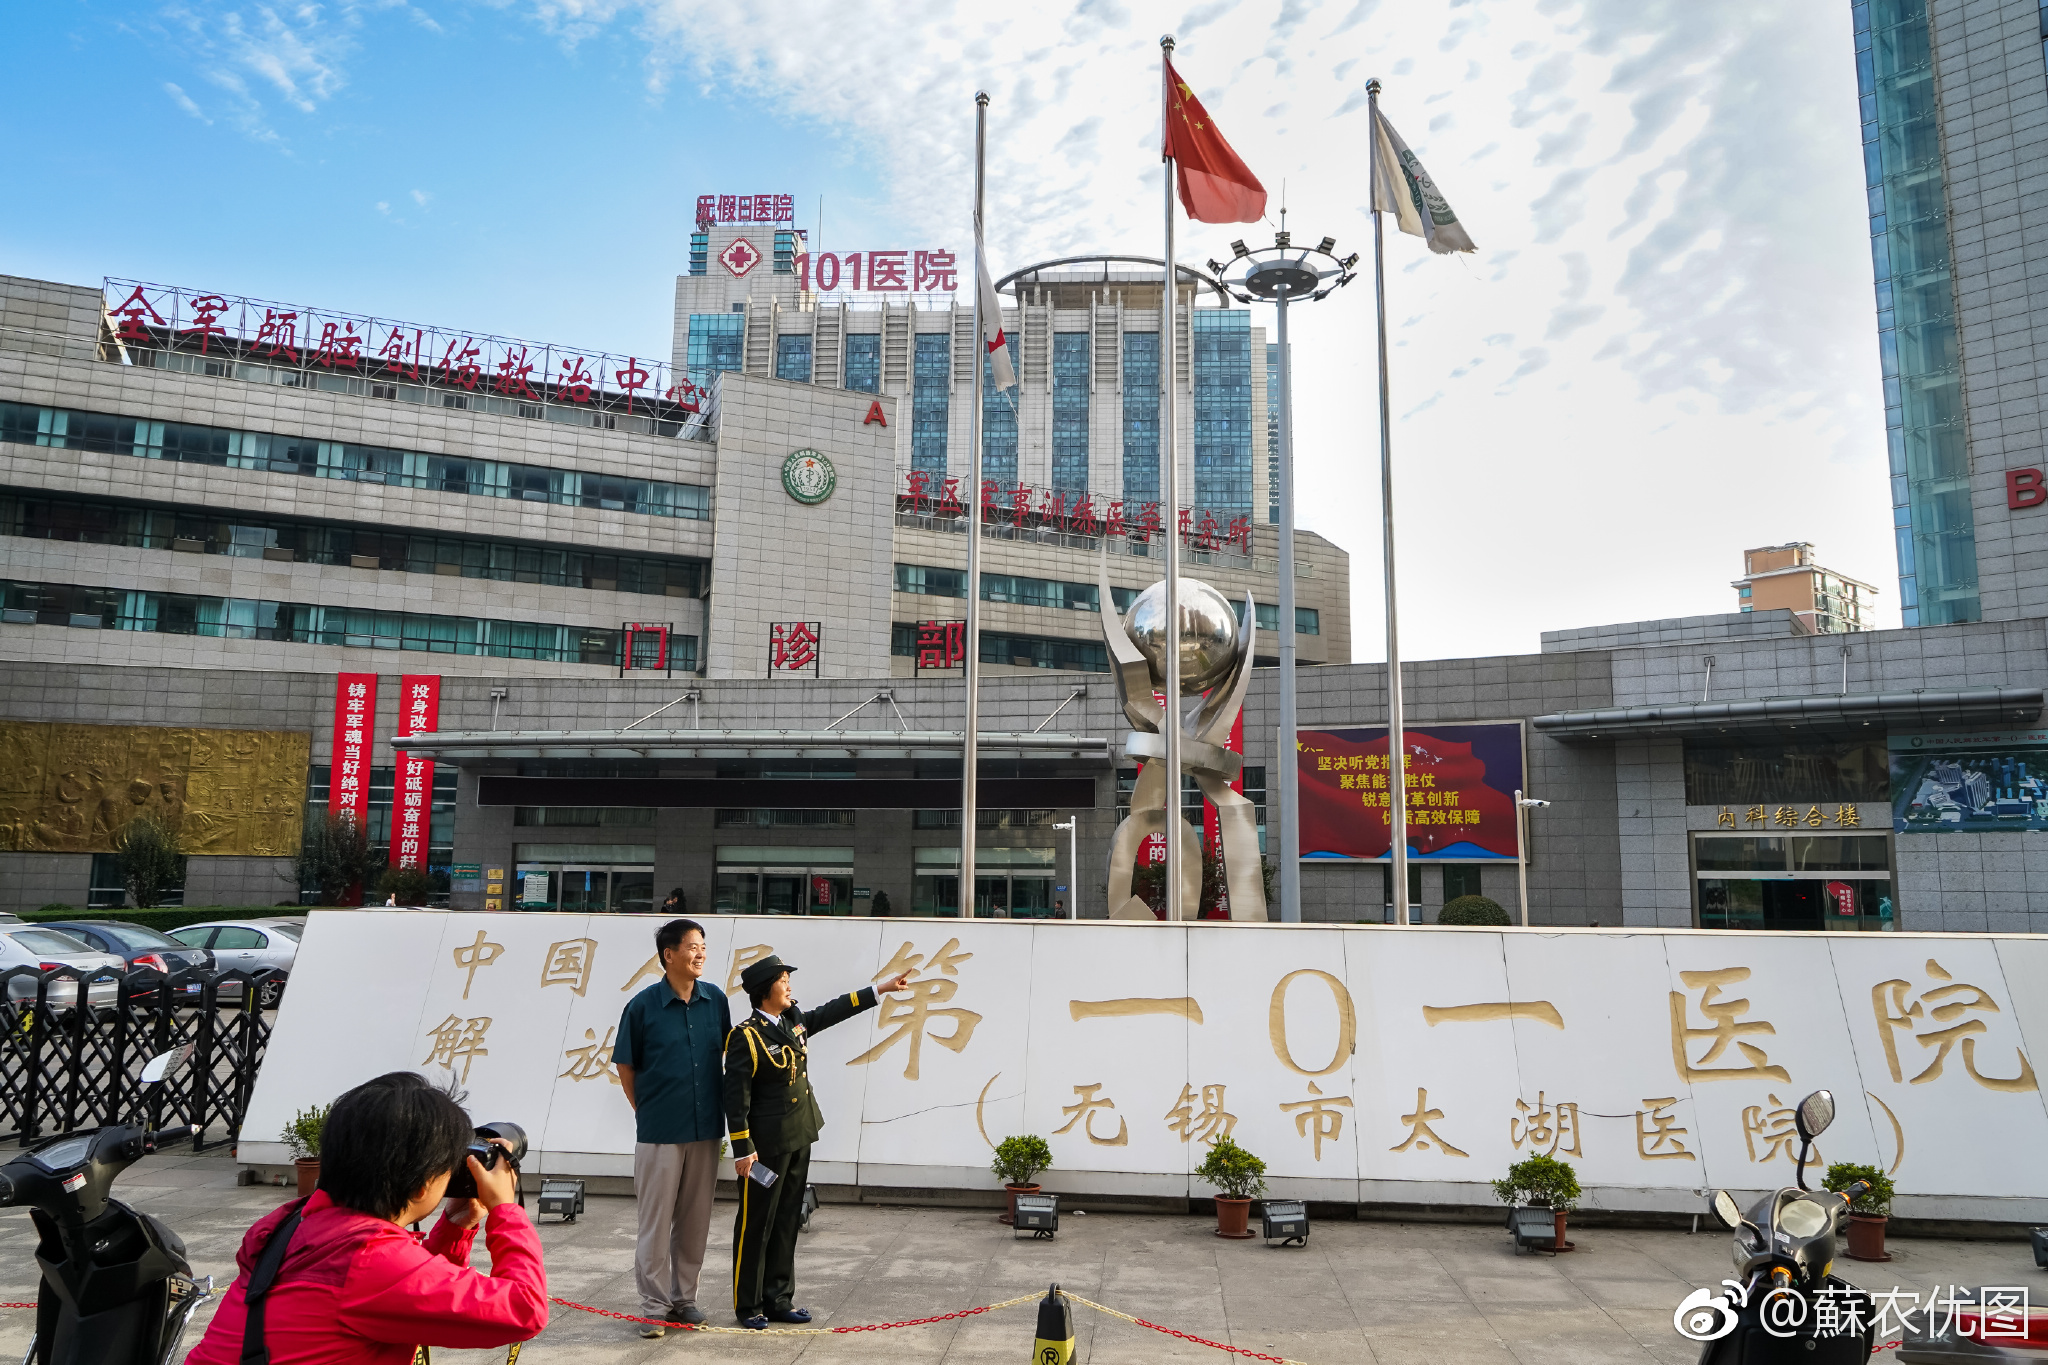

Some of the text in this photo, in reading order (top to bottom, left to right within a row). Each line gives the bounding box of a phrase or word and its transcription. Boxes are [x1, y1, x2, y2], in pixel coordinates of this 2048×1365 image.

[794, 249, 958, 291] 101医院
[108, 286, 707, 414] 全军颅脑创伤救治中心
[864, 401, 887, 427] A
[2006, 468, 2047, 510] B
[625, 621, 964, 671] 门诊部
[339, 683, 367, 838] 铸牢军魂当好绝对忠
[400, 684, 430, 870] 投身改好砥砺奋进的赶
[1340, 773, 1435, 789] 聚焦能胜仗
[1718, 803, 1861, 829] 内科综合楼
